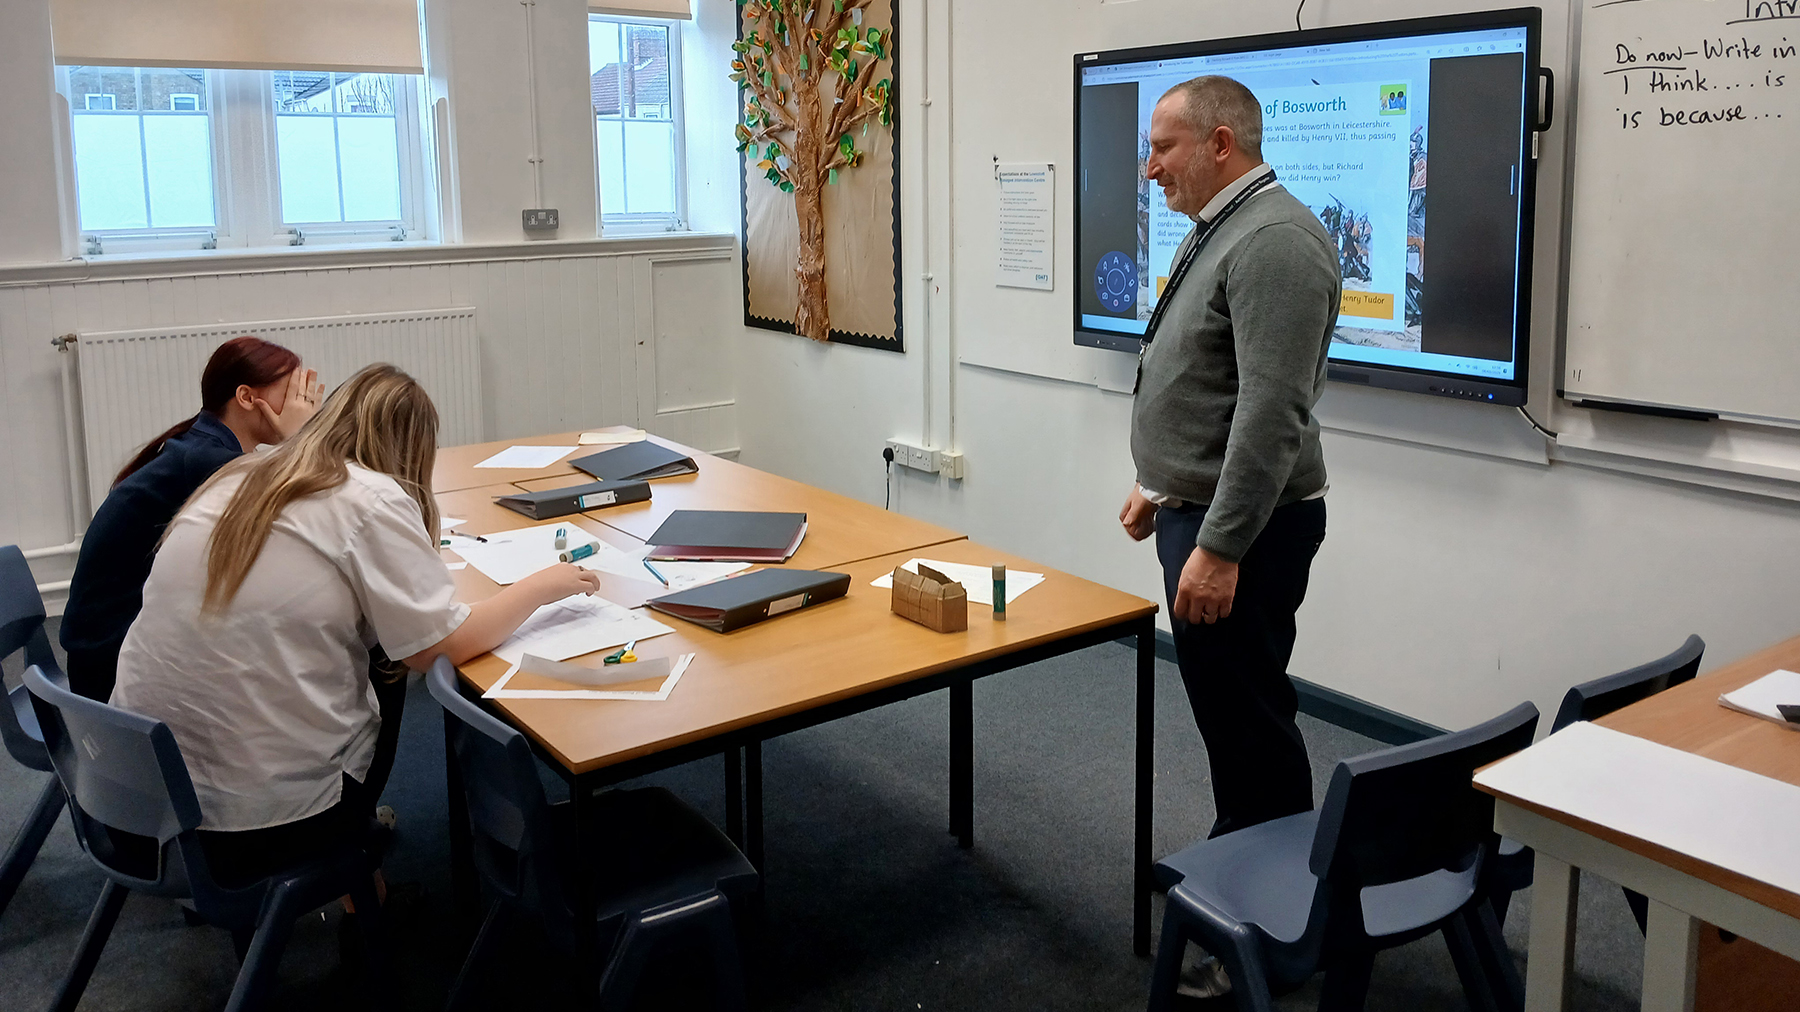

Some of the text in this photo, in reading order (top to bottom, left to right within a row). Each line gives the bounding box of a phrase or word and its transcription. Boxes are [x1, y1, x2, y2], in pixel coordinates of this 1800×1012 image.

[1746, 0, 1800, 18] Intr
[1616, 43, 1637, 63] Do
[1704, 37, 1762, 59] Write
[1773, 37, 1796, 58] in
[1766, 70, 1785, 86] is
[1265, 96, 1347, 119] of Bosworth
[1616, 107, 1642, 129] is
[1299, 122, 1331, 131] Bosworth
[1342, 120, 1392, 129] Leicestershire.
[1282, 134, 1299, 142] killed
[1301, 134, 1310, 143] by
[1312, 133, 1333, 142] Henry
[1350, 132, 1366, 140] thus
[1368, 132, 1396, 142] passing
[1302, 163, 1320, 172] sides,
[1336, 162, 1364, 170] Richard
[1301, 174, 1321, 183] Henry
[1364, 295, 1385, 304] Tudor
